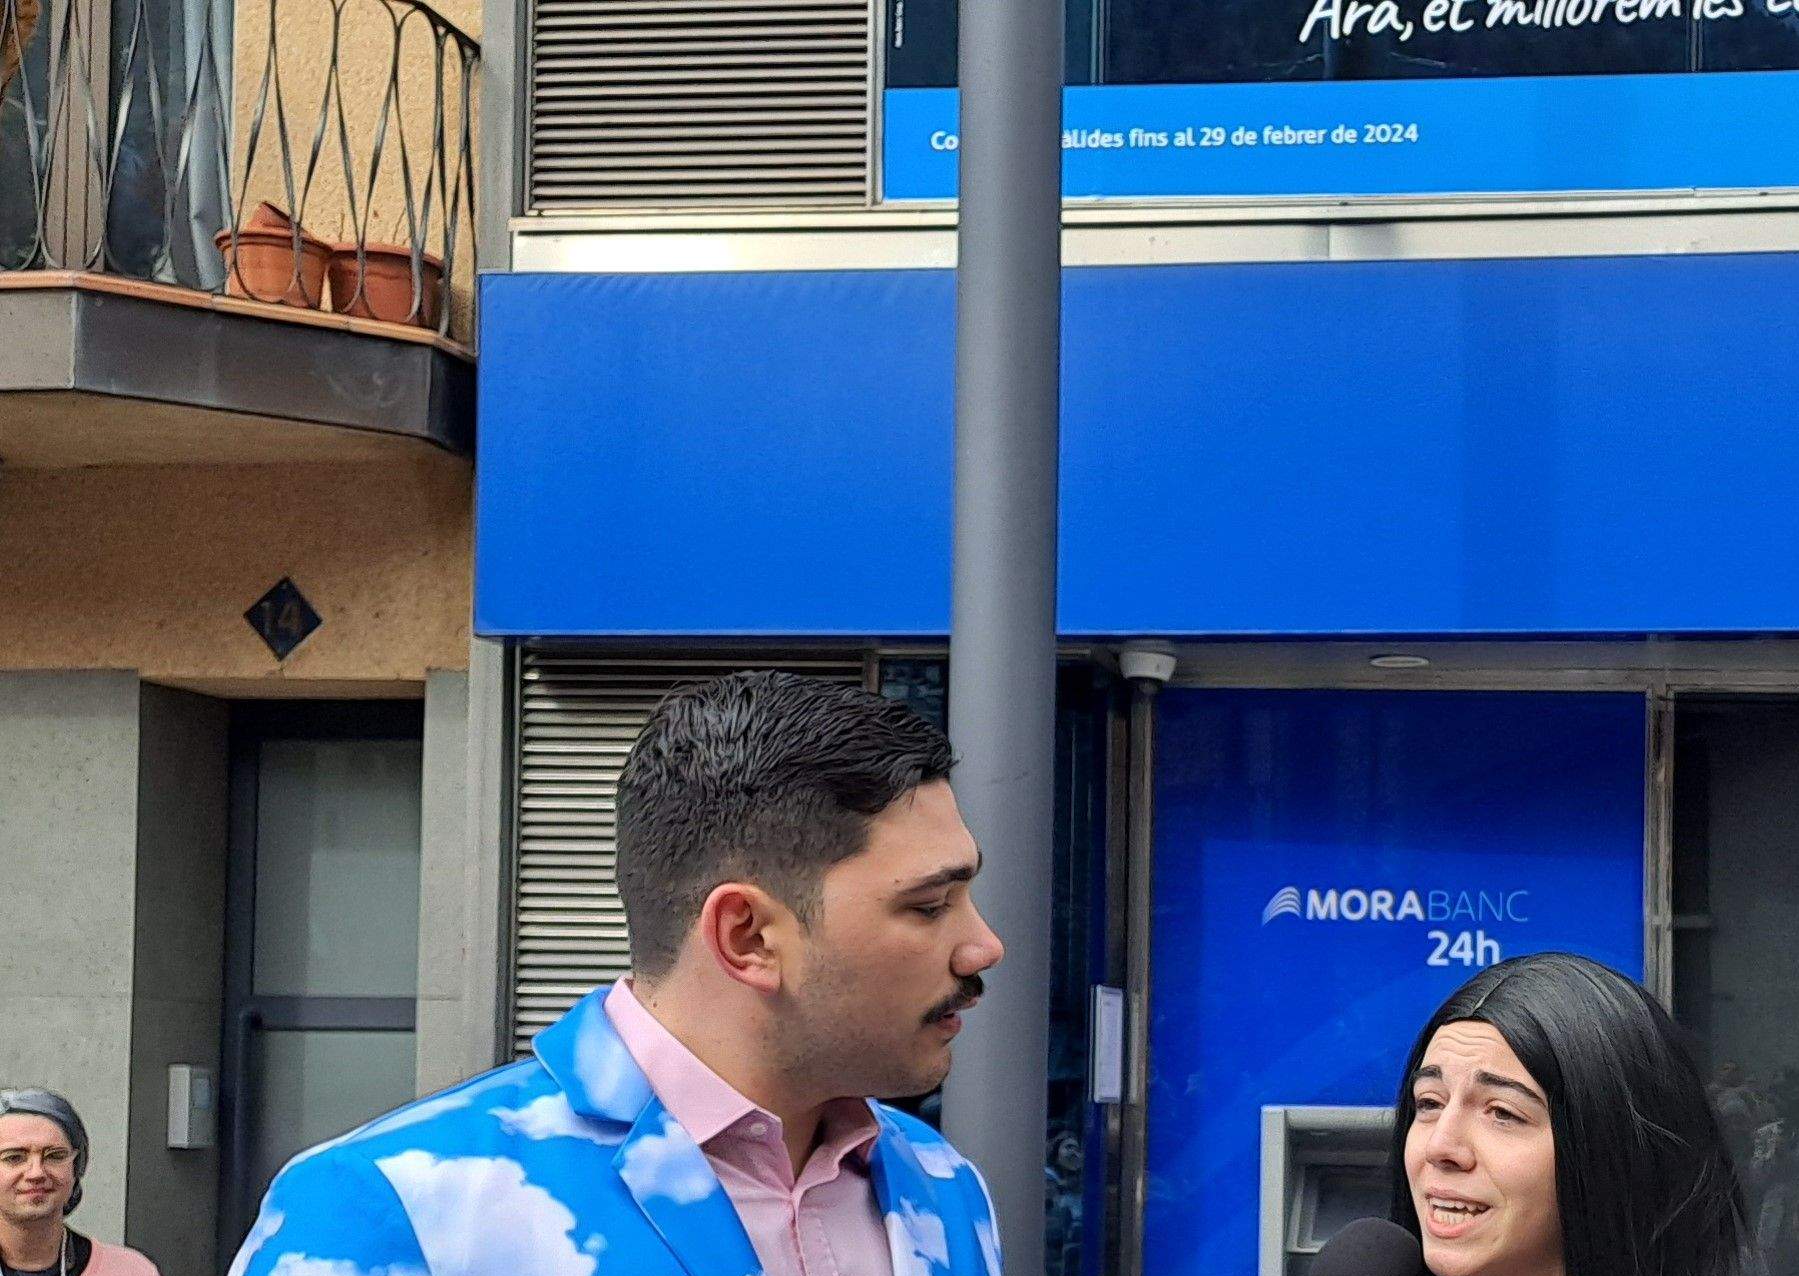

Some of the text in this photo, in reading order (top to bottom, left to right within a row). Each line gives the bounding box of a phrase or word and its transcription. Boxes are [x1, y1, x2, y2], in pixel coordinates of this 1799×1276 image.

[1061, 123, 1419, 149] àlides fins al 29 de febrer de 2024
[1306, 889, 1529, 921] MORABANC
[1427, 930, 1500, 967] 24h
